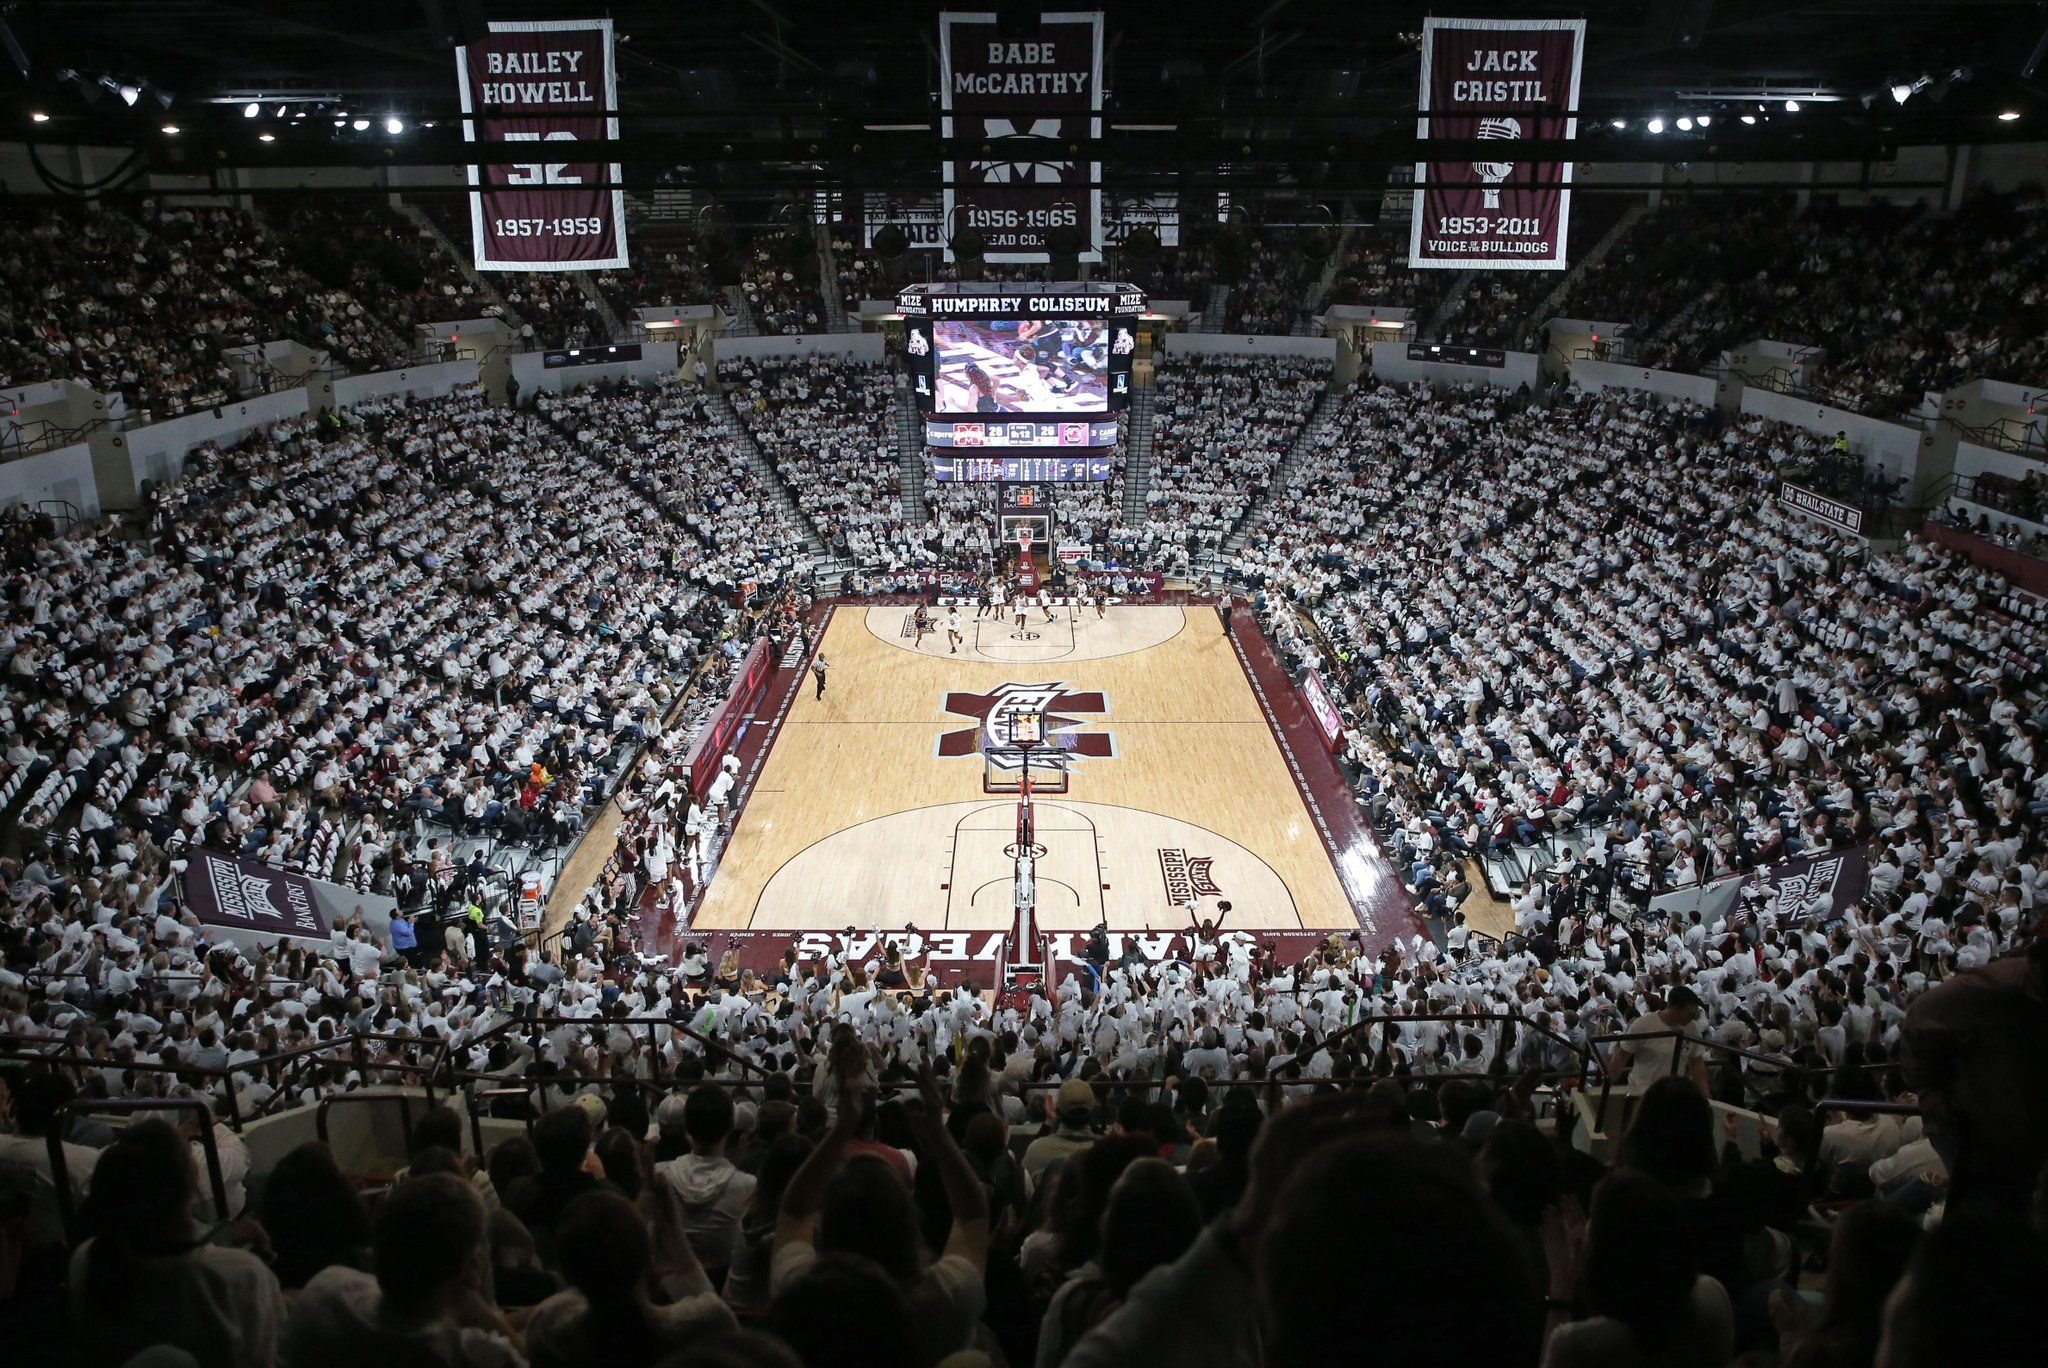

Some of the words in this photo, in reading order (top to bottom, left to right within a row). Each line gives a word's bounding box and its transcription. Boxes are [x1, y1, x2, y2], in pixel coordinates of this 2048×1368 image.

[487, 51, 583, 74] BAILEY
[988, 43, 1055, 64] BABE
[1467, 50, 1538, 72] JACK
[482, 81, 593, 103] HOWELL
[955, 72, 1088, 94] McCARTHY
[1453, 81, 1546, 102] CRISTIL
[496, 217, 601, 236] 1957-1959
[968, 209, 1077, 228] 1956-1965
[1439, 216, 1540, 235] 1953-2011
[982, 234, 1017, 246] EAD
[1428, 240, 1468, 252] VOICE
[1481, 240, 1549, 253] BULLDOGS
[901, 294, 922, 306] MIZE
[931, 297, 1022, 313] HUMPHREY
[1029, 297, 1110, 312] COLISEUM
[1114, 305, 1146, 314] FOUNDATION
[1120, 294, 1142, 306] MIZE
[896, 306, 927, 315] FOUNDATION
[1796, 492, 1845, 521] #HAILSTATE
[1012, 633, 1039, 641] SEC
[1193, 862, 1211, 891] STATE
[211, 856, 248, 919] MISSISSIPPI
[249, 881, 274, 911] STATE
